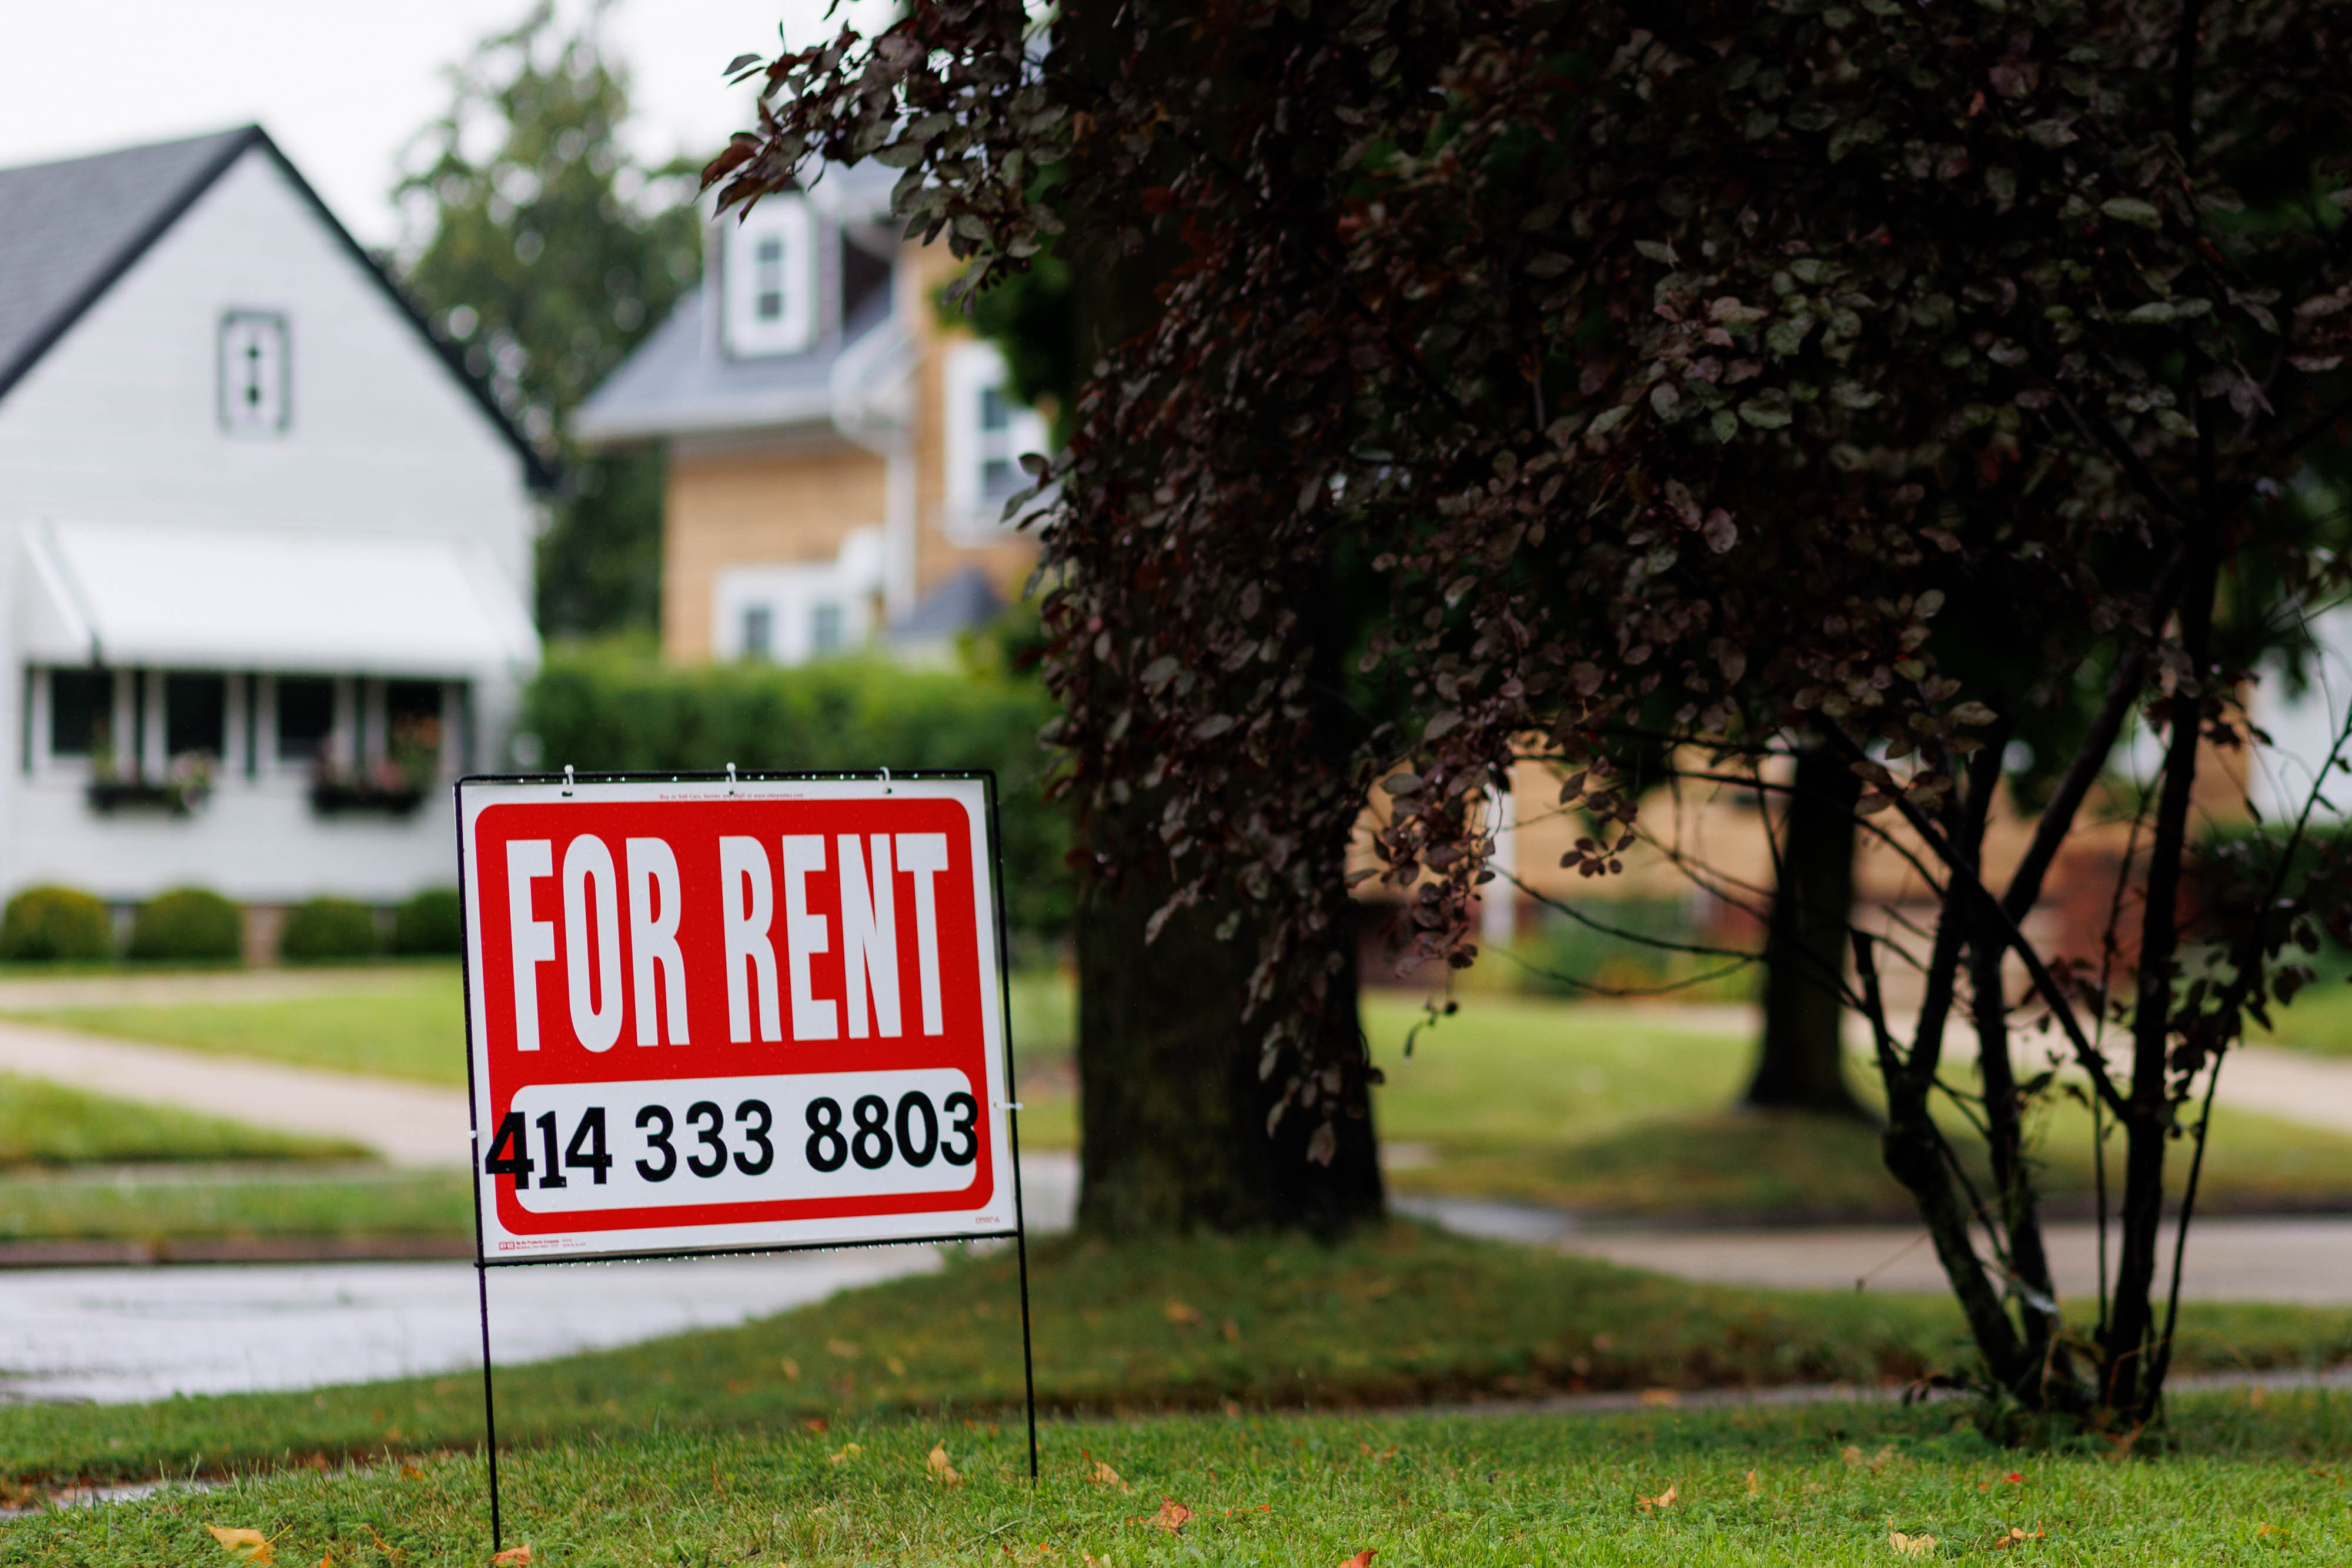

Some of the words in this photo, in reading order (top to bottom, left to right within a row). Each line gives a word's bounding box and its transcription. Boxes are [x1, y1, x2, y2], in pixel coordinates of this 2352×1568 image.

[505, 834, 690, 1053] FOR
[719, 833, 948, 1044] RENT
[485, 1107, 613, 1190] 414
[635, 1099, 774, 1182] 333
[806, 1091, 978, 1172] 8803
